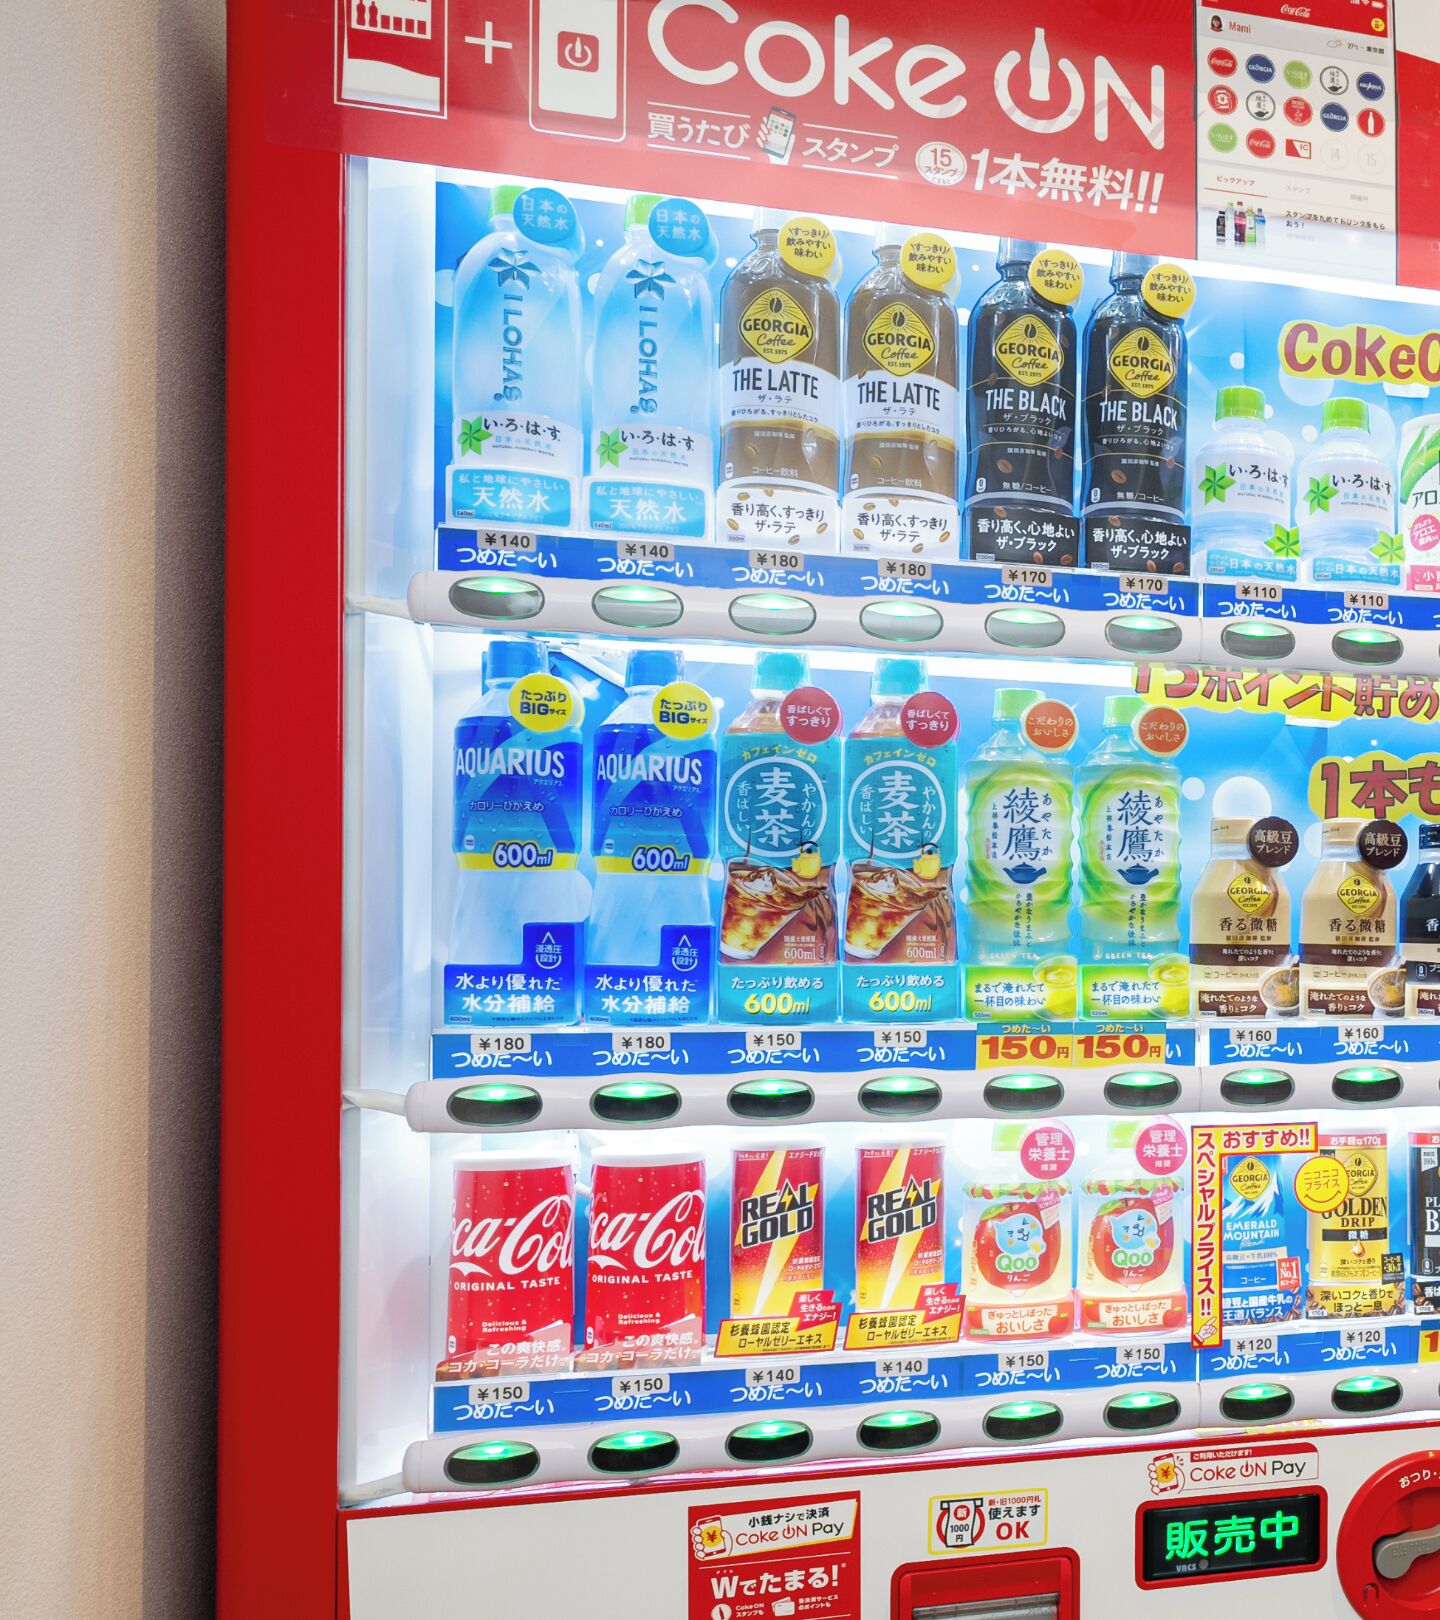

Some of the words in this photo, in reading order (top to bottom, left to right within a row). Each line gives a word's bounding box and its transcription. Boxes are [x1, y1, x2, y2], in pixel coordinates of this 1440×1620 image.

[1229, 21, 1251, 33] Mami
[647, 0, 966, 118] Coke
[647, 111, 750, 150] 買うたび
[803, 135, 900, 169] スタンプ
[930, 148, 952, 166] 15
[1216, 176, 1255, 186] ピックアップ
[521, 198, 567, 214] 日本の
[1285, 210, 1385, 230] スタンプをためてドリンクをもら
[908, 252, 952, 266] 飲みやすい
[915, 262, 945, 274] 味わい
[743, 318, 811, 338] GEORGIA
[756, 334, 796, 347] Coffee
[998, 342, 1060, 361] GEORGIA
[857, 381, 888, 405] THE
[892, 382, 941, 411] LATTE
[1100, 400, 1126, 423] THE
[1128, 402, 1178, 431] BLACK
[751, 466, 799, 479] コーヒー飲料
[458, 473, 564, 491] 私と地球にやさしい
[472, 487, 551, 512] 天然水
[730, 502, 825, 522] 香り高く、すっきり
[977, 518, 1075, 538] 香り高く、心地よい
[624, 543, 669, 559] ¥140
[1229, 557, 1296, 574] 日本の天然水
[1125, 578, 1163, 592] ¥170
[519, 688, 567, 703] たっぷり
[786, 704, 832, 717] 香ばしくて
[785, 715, 832, 729] すっきり
[1027, 715, 1074, 729] こだわりの
[455, 748, 565, 777] AQUARIUS
[740, 745, 819, 764] カフェインゼロ
[469, 800, 545, 814] カロリーひかえめ
[734, 780, 752, 832] 香ばしい
[755, 767, 800, 848] 麦茶
[800, 782, 818, 838] やかんの
[1002, 787, 1043, 862] 綾鷹
[1041, 792, 1054, 857] あやたか
[1218, 918, 1278, 933] 香る微糖
[454, 973, 561, 992] 水より優れた
[730, 976, 824, 990] たっぷり飲める
[974, 981, 1045, 994] まるで淹れたて
[462, 995, 555, 1015] 水分補給
[743, 992, 811, 1016] 600ml
[974, 995, 1046, 1007] 一杯目の味わい
[1218, 1003, 1257, 1015] 香りとコク
[620, 1036, 666, 1049] ¥180
[1236, 1028, 1273, 1042] ¥160
[478, 1036, 525, 1051] ¥180
[980, 1033, 1069, 1060] 150円
[1076, 1033, 1161, 1059] 150円
[1034, 1131, 1064, 1146] 管理
[1028, 1146, 1071, 1162] 栄養士
[1040, 1163, 1057, 1172] 推奨
[1304, 1169, 1339, 1181] ニコニコ
[1305, 1179, 1340, 1191] プライス
[742, 1177, 813, 1223] REAL
[742, 1203, 814, 1248] GOLD
[1226, 1220, 1277, 1231] EMERALD
[1341, 1218, 1375, 1227] DRIP
[1223, 1229, 1280, 1241] MOUNTAIN
[996, 1253, 1038, 1272] Qoo
[454, 1281, 515, 1291] ORIGINAL
[520, 1276, 561, 1289] TASTE
[1006, 1271, 1030, 1282] りんご
[799, 1294, 821, 1302] 楽しく
[1320, 1290, 1393, 1300] 深いコクと香りで
[986, 1306, 1052, 1320] ぎゅっとしぼった
[1334, 1301, 1382, 1312] ほっと一息
[730, 1321, 790, 1336] 杉養蜂園認定
[995, 1319, 1045, 1335] おいしさ
[738, 1334, 822, 1347] ローヤルゼリーエキス
[1345, 1329, 1381, 1344] ¥120
[487, 1338, 567, 1358] この爽快感。
[882, 1358, 923, 1374] ¥140
[619, 1378, 663, 1393] ¥150
[1189, 1466, 1236, 1482] Coke
[1271, 1460, 1306, 1477] Pay
[748, 1506, 830, 1528] 小銭ナシで決済
[987, 1504, 1041, 1520] 使えます
[736, 1529, 779, 1546] Coke
[812, 1522, 844, 1537] Pay
[995, 1519, 1030, 1541] OK
[1165, 1510, 1299, 1560] 販売中
[711, 1564, 839, 1599] Wでたまる!
